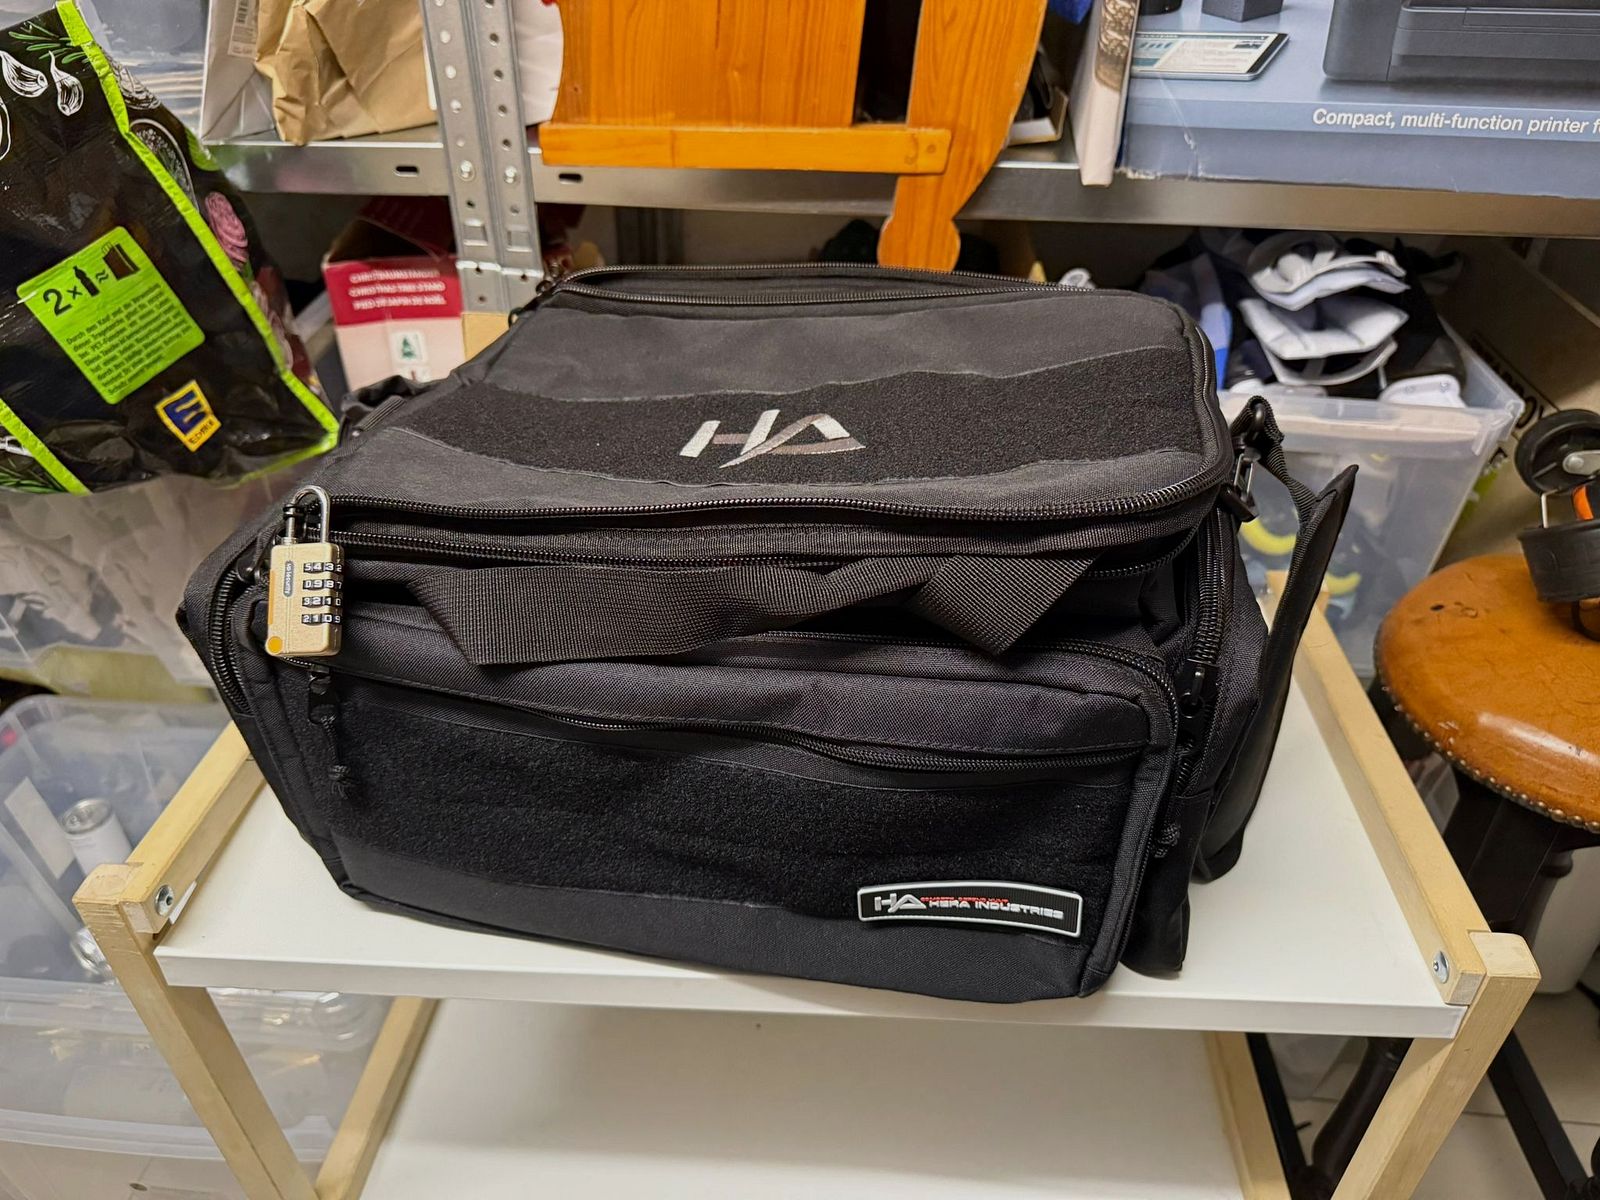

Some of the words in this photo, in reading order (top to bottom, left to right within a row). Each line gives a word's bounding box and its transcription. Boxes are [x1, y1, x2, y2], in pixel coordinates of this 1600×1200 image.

[1312, 107, 1396, 129] Compact,
[1400, 110, 1523, 132] multi-function
[1526, 116, 1589, 135] printer
[929, 900, 970, 909] HERA
[975, 900, 1064, 919] INDUSTRIES
